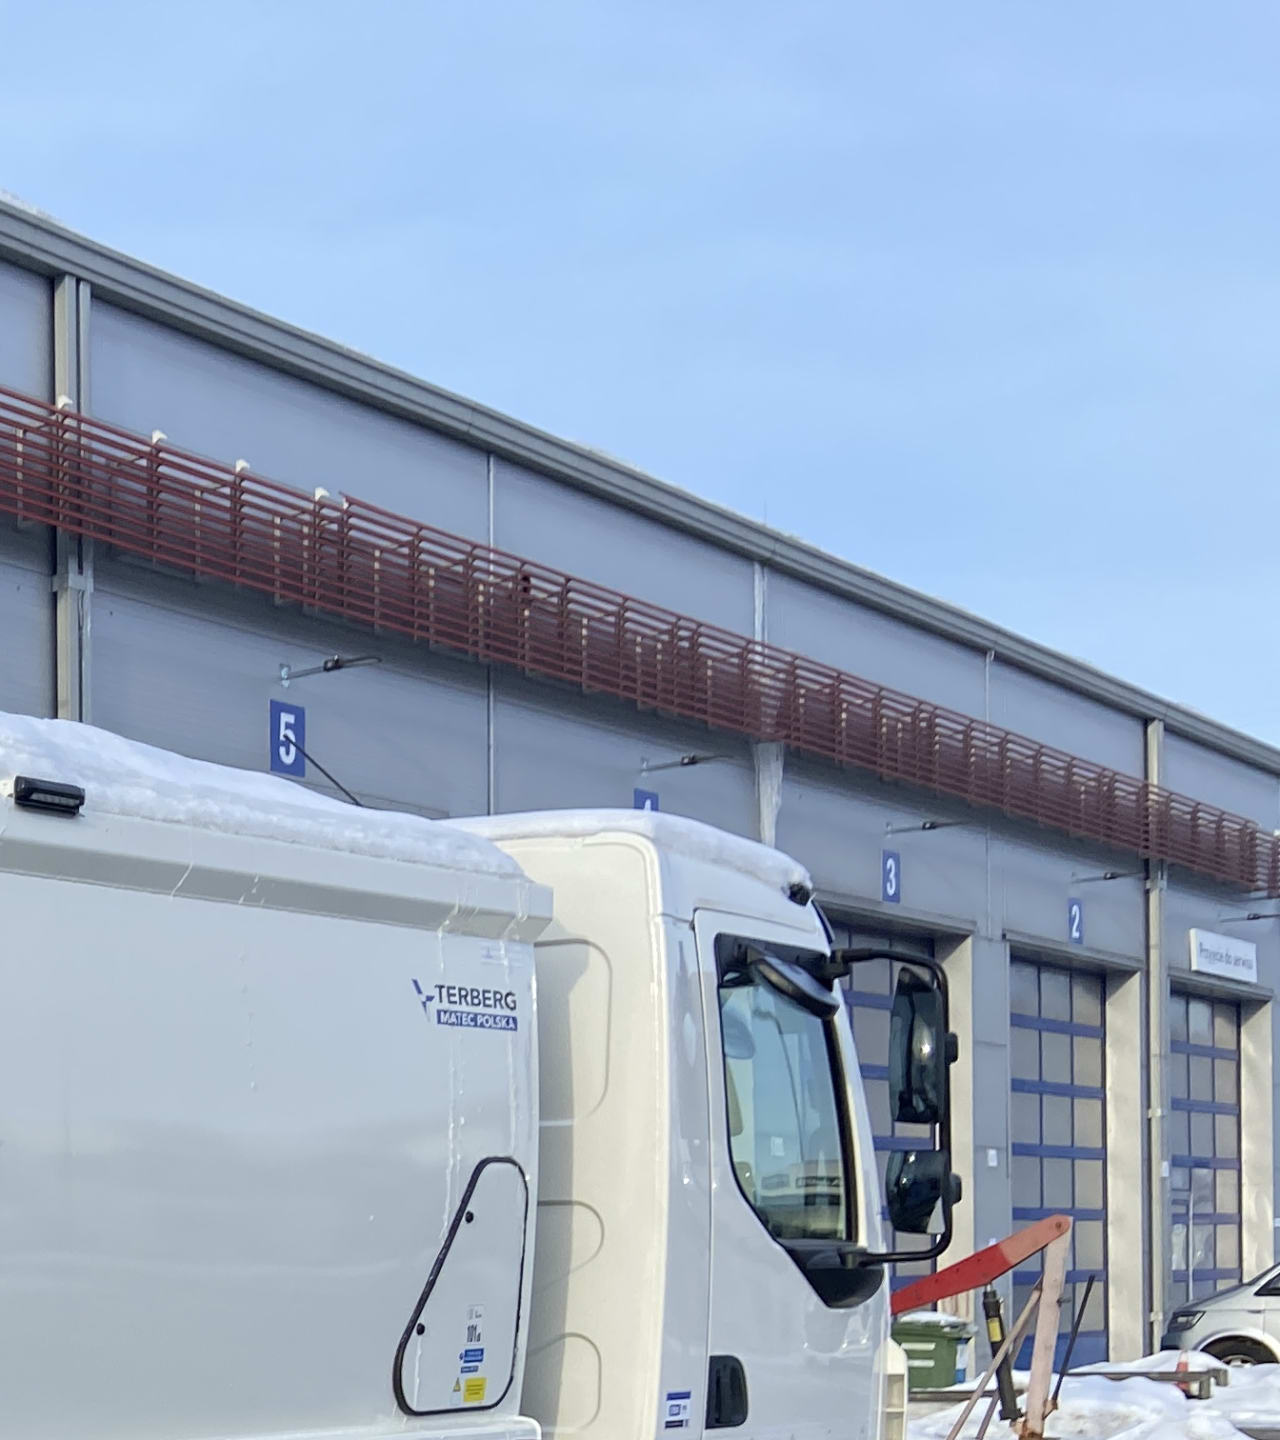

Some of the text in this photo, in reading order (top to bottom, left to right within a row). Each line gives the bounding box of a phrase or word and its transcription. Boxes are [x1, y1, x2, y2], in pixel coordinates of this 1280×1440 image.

[279, 711, 296, 765] 5
[886, 858, 896, 896] 3
[1071, 904, 1080, 939] 2
[434, 984, 517, 1011] TERBERG
[440, 1011, 516, 1029] MATEC POLSKA
